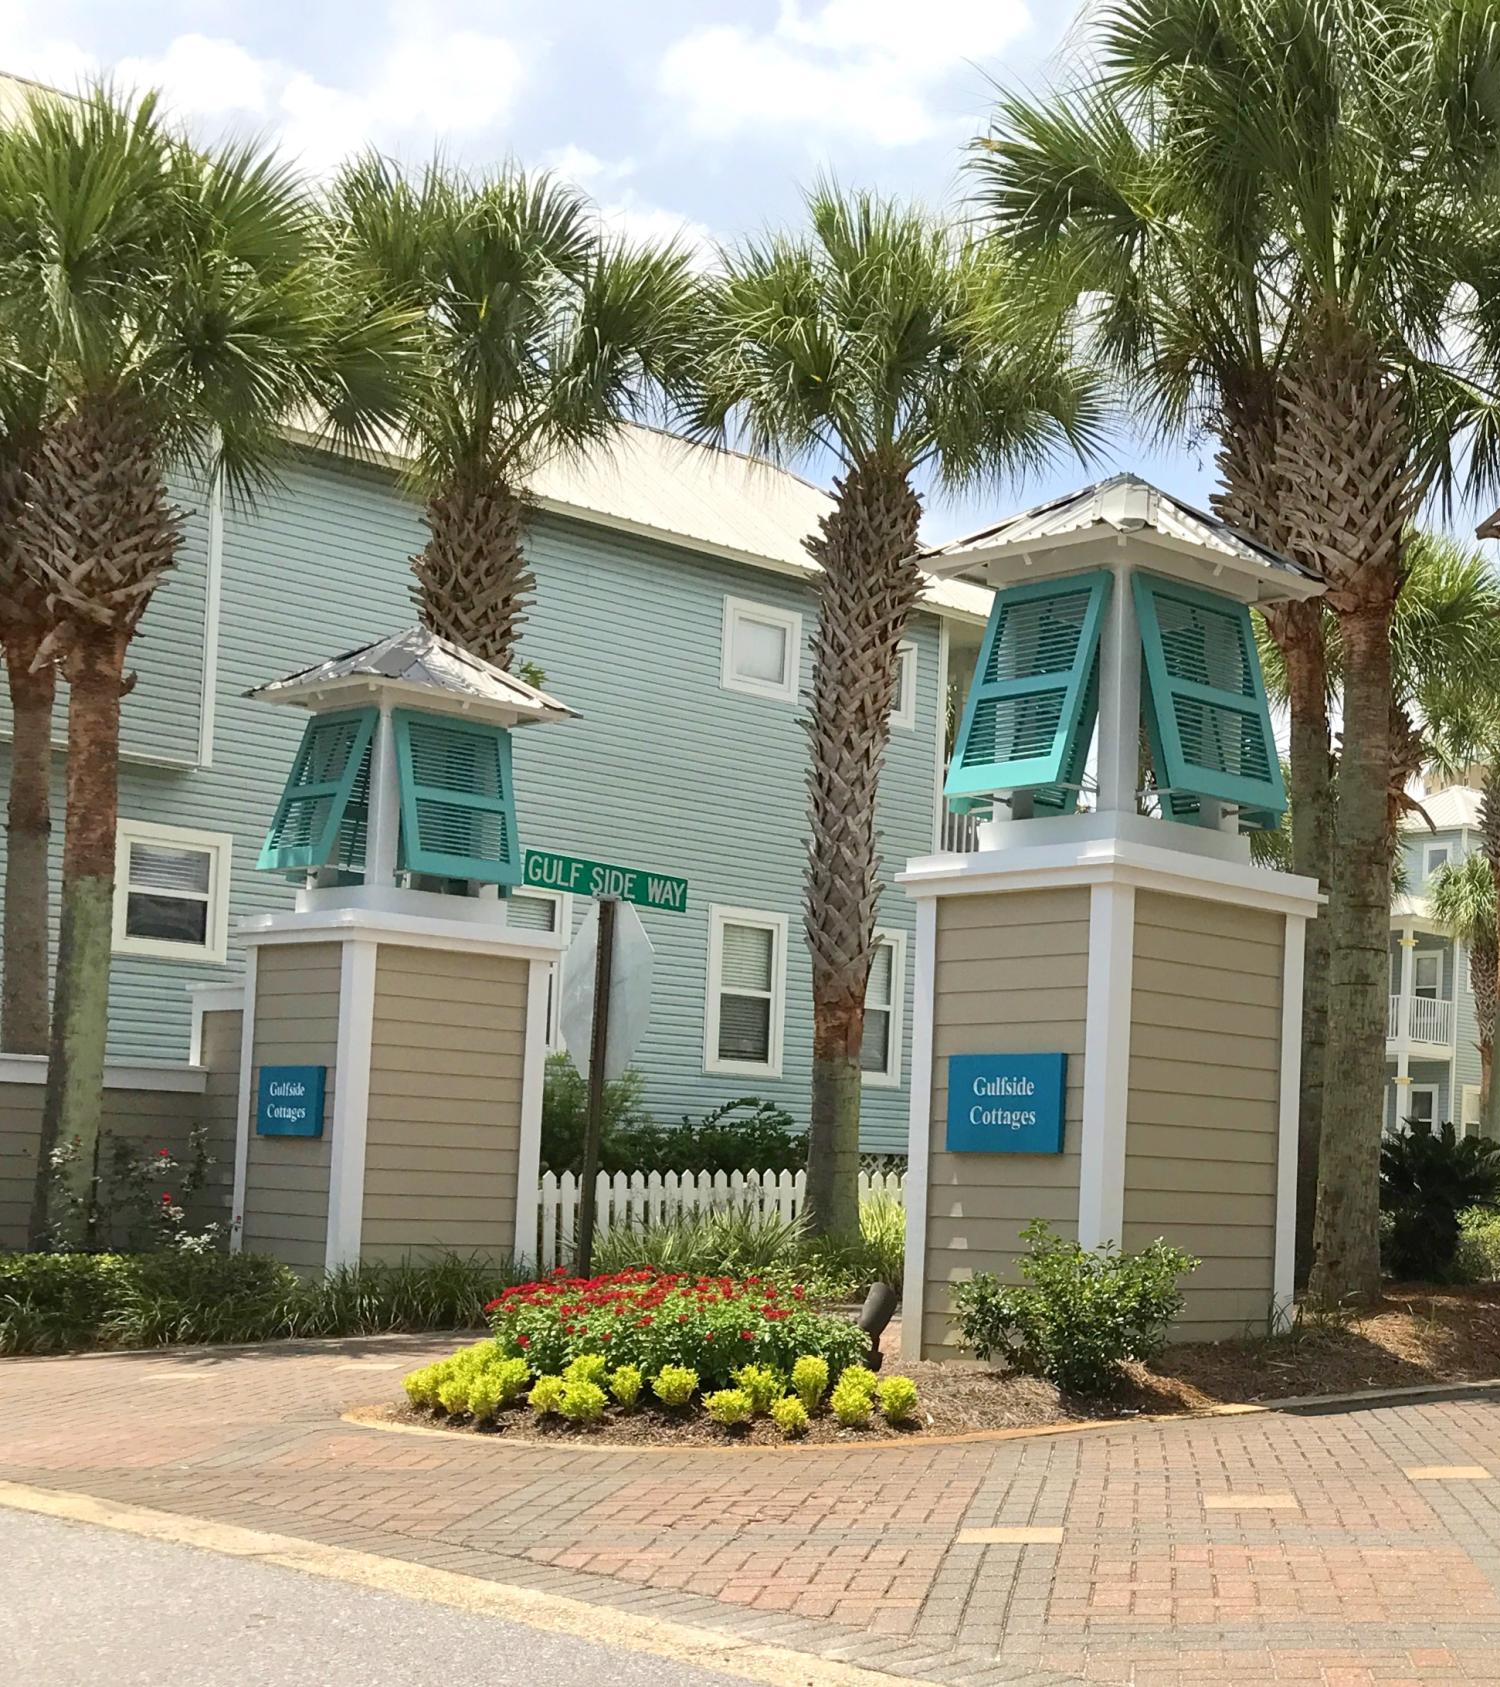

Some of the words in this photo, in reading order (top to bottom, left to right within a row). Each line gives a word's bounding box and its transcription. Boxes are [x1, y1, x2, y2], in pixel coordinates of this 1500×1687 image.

[528, 855, 584, 888] GULF
[589, 866, 637, 899] SIDE
[647, 876, 686, 907] WAY
[269, 1081, 306, 1097] Gulfside
[972, 1076, 1035, 1096] Gulfside
[266, 1103, 306, 1122] Cottages
[969, 1105, 1037, 1130] Cottages
